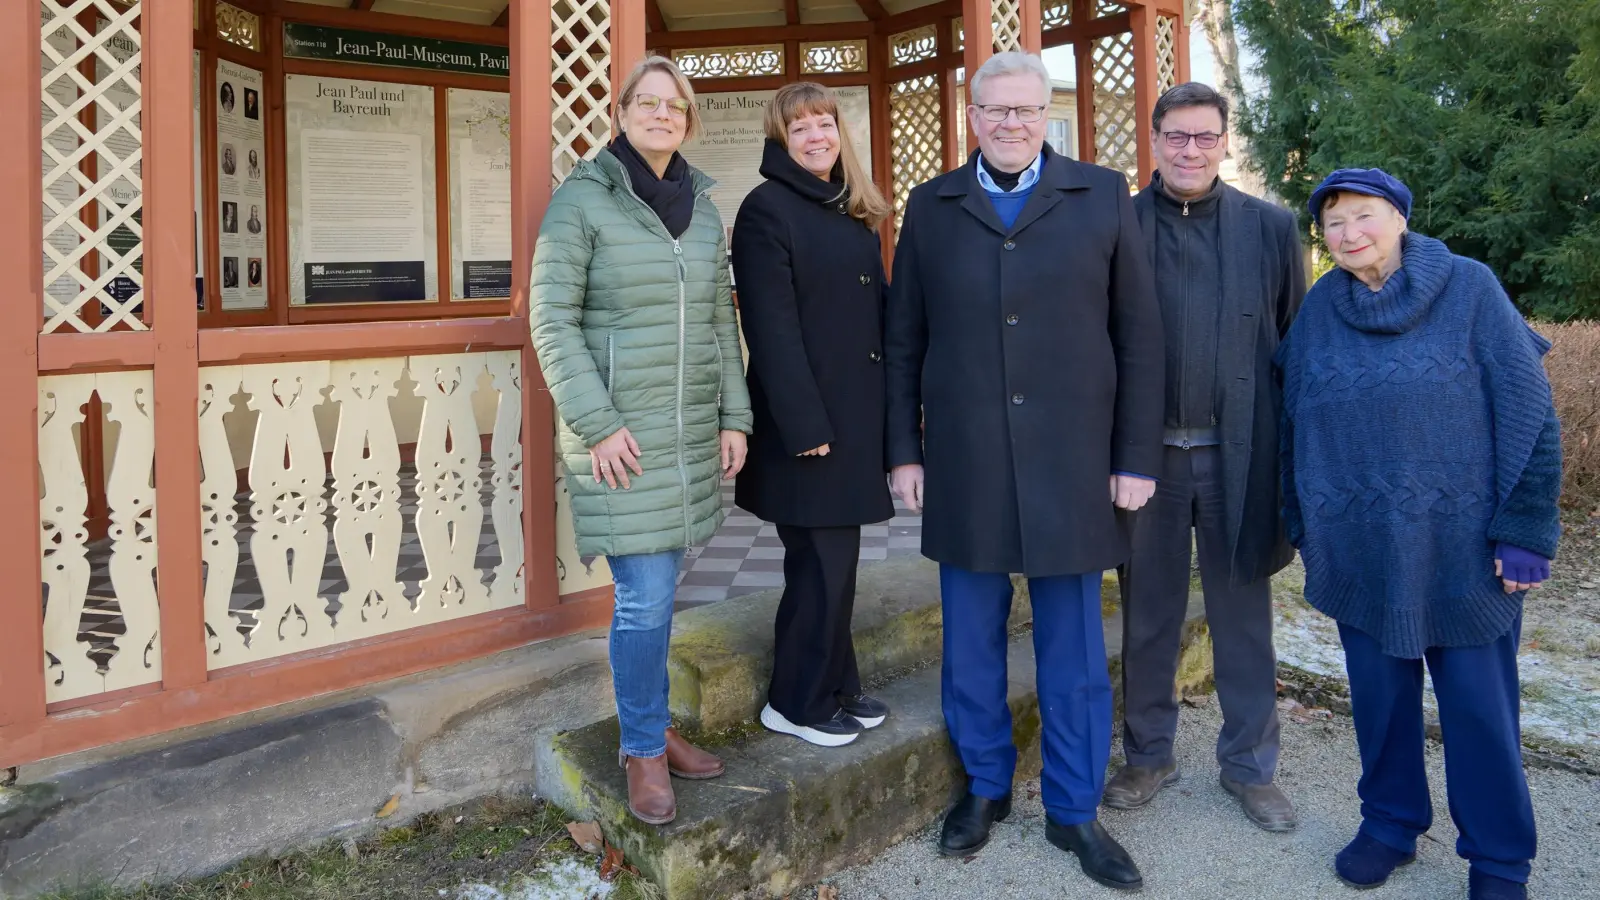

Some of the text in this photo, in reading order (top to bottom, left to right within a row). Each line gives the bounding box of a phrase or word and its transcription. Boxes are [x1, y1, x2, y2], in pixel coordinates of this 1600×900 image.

[294, 38, 327, 48] Station 118
[336, 37, 510, 70] Jean-Paul-Museum, Pavil
[316, 82, 405, 102] Jean Paul und
[332, 99, 391, 118] Bayreuth
[696, 96, 768, 110] n-Paul-Muse
[712, 137, 729, 146] Stadt
[730, 136, 759, 145] Bayreuth
